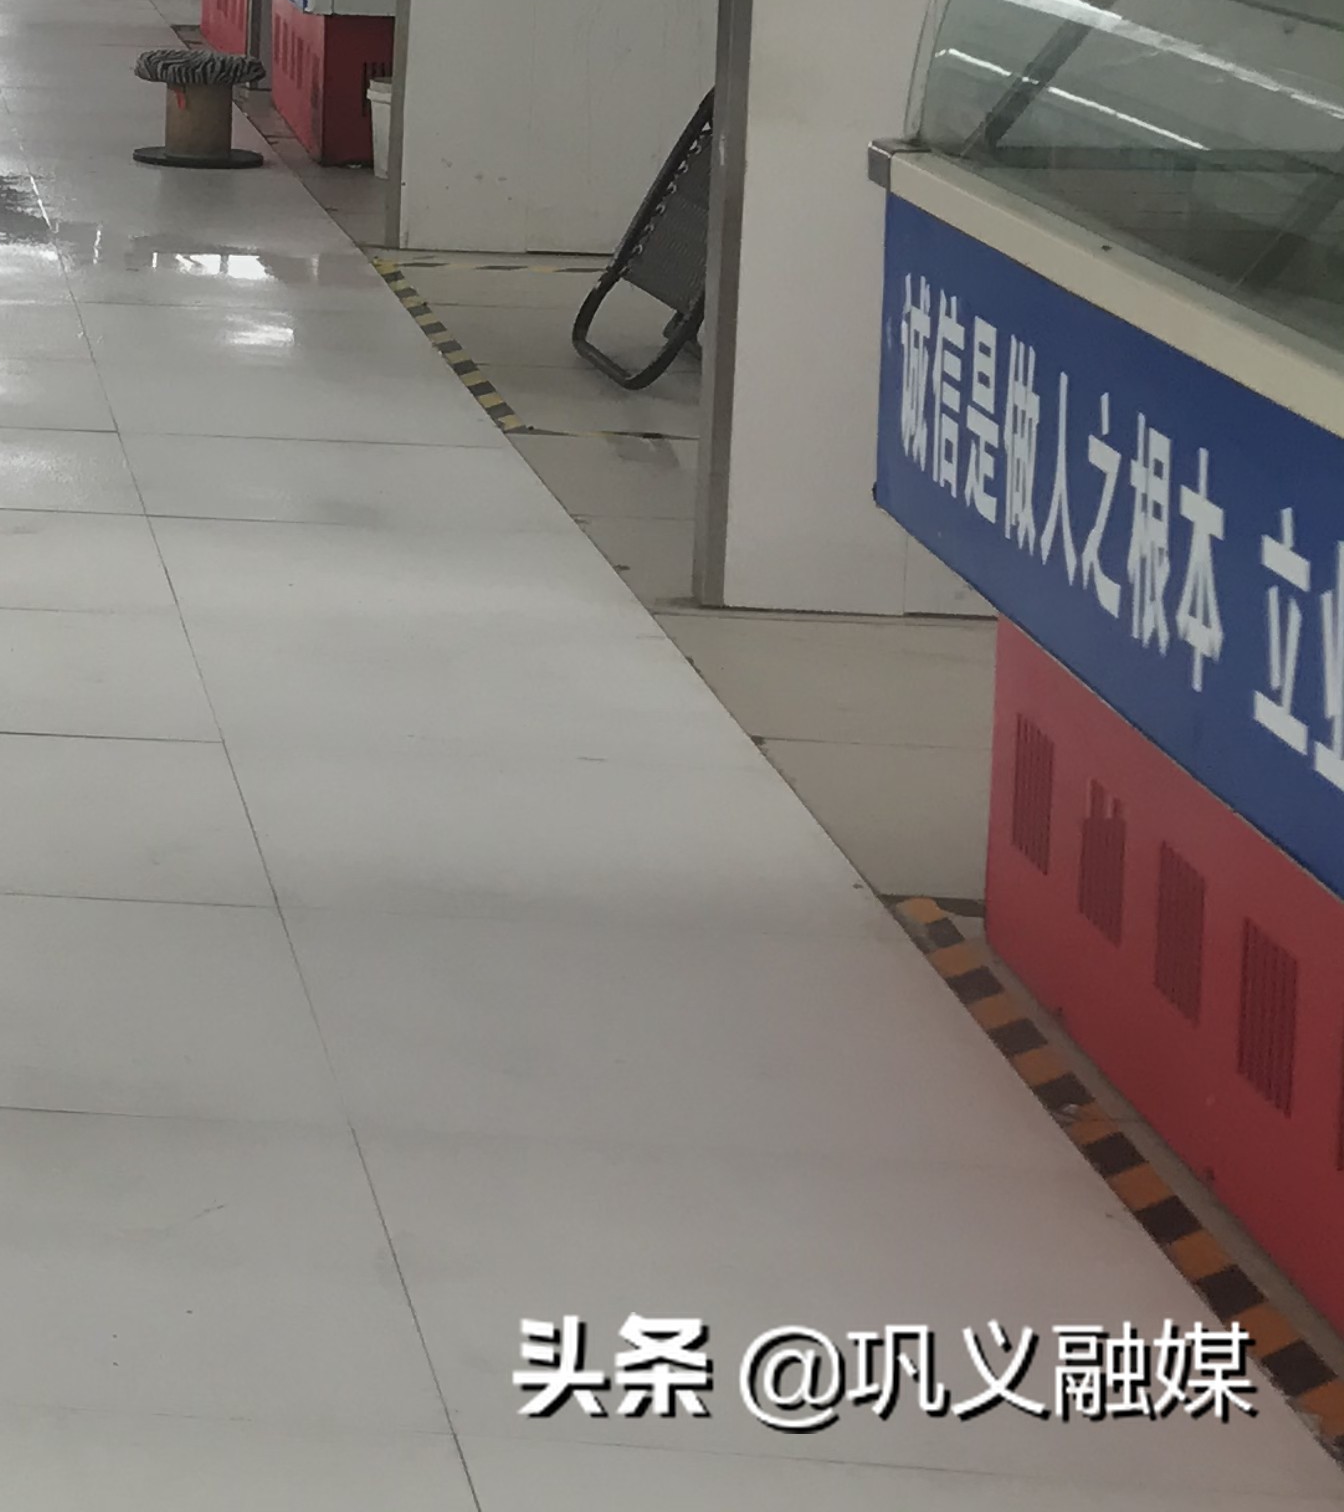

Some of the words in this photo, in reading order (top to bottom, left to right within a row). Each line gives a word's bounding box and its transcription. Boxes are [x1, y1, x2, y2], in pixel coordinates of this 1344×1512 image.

[900, 273, 1224, 692] 诚信是做人之根本
